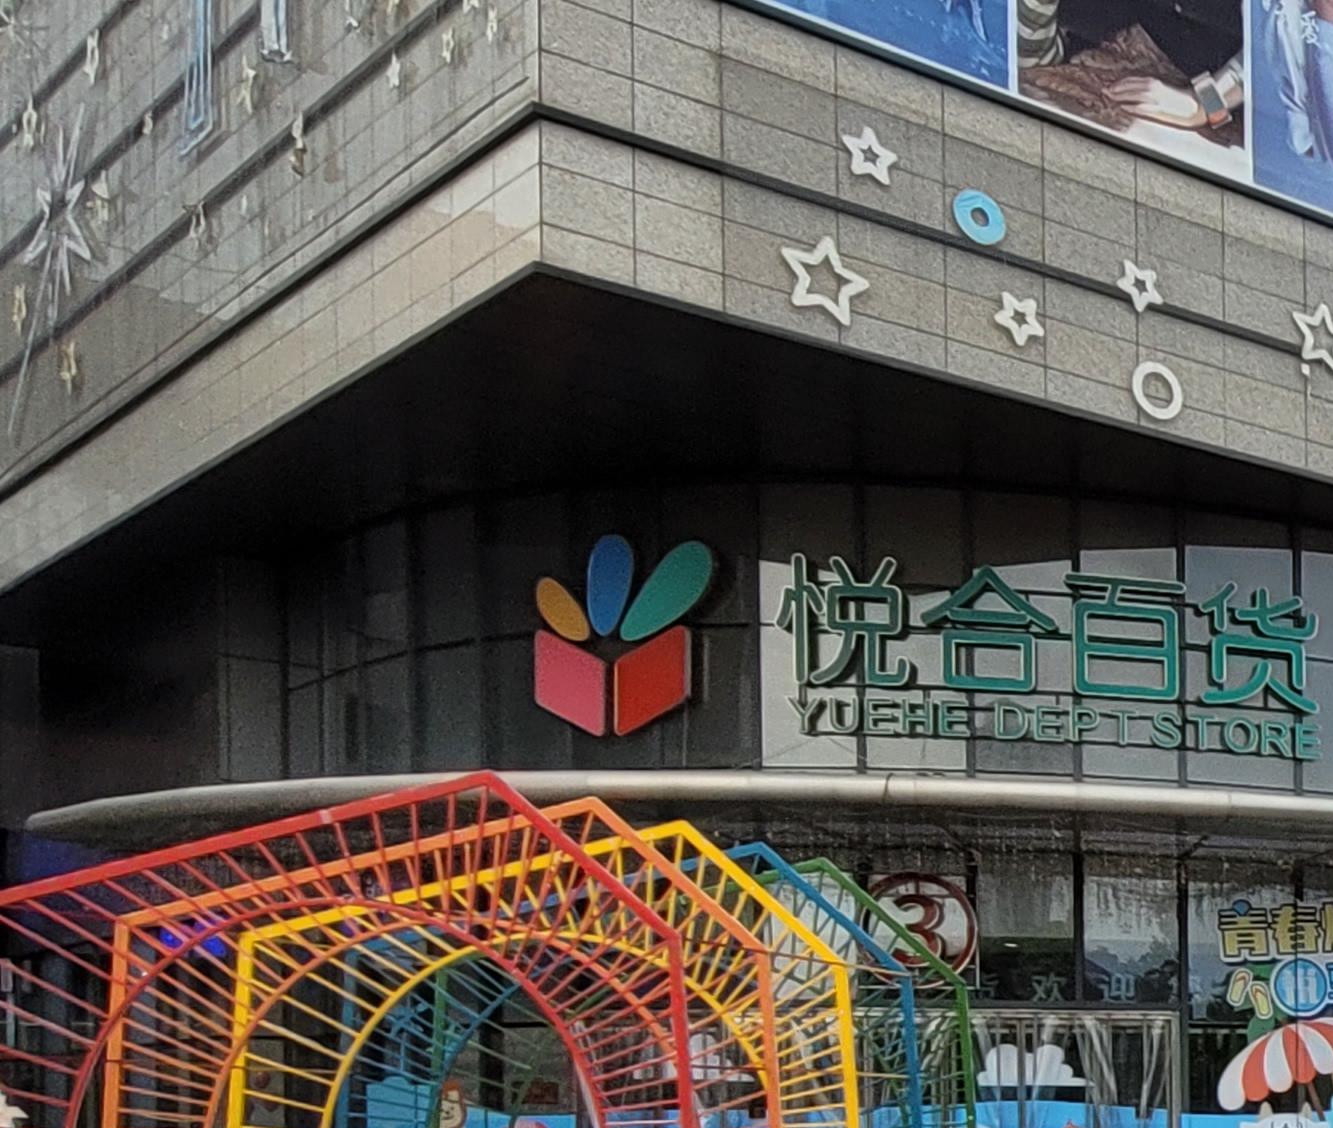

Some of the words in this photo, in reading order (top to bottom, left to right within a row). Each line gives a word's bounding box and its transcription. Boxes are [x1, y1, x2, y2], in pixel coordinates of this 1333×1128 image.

[775, 552, 1320, 715] 悦合百货
[785, 695, 971, 738] YUEHE
